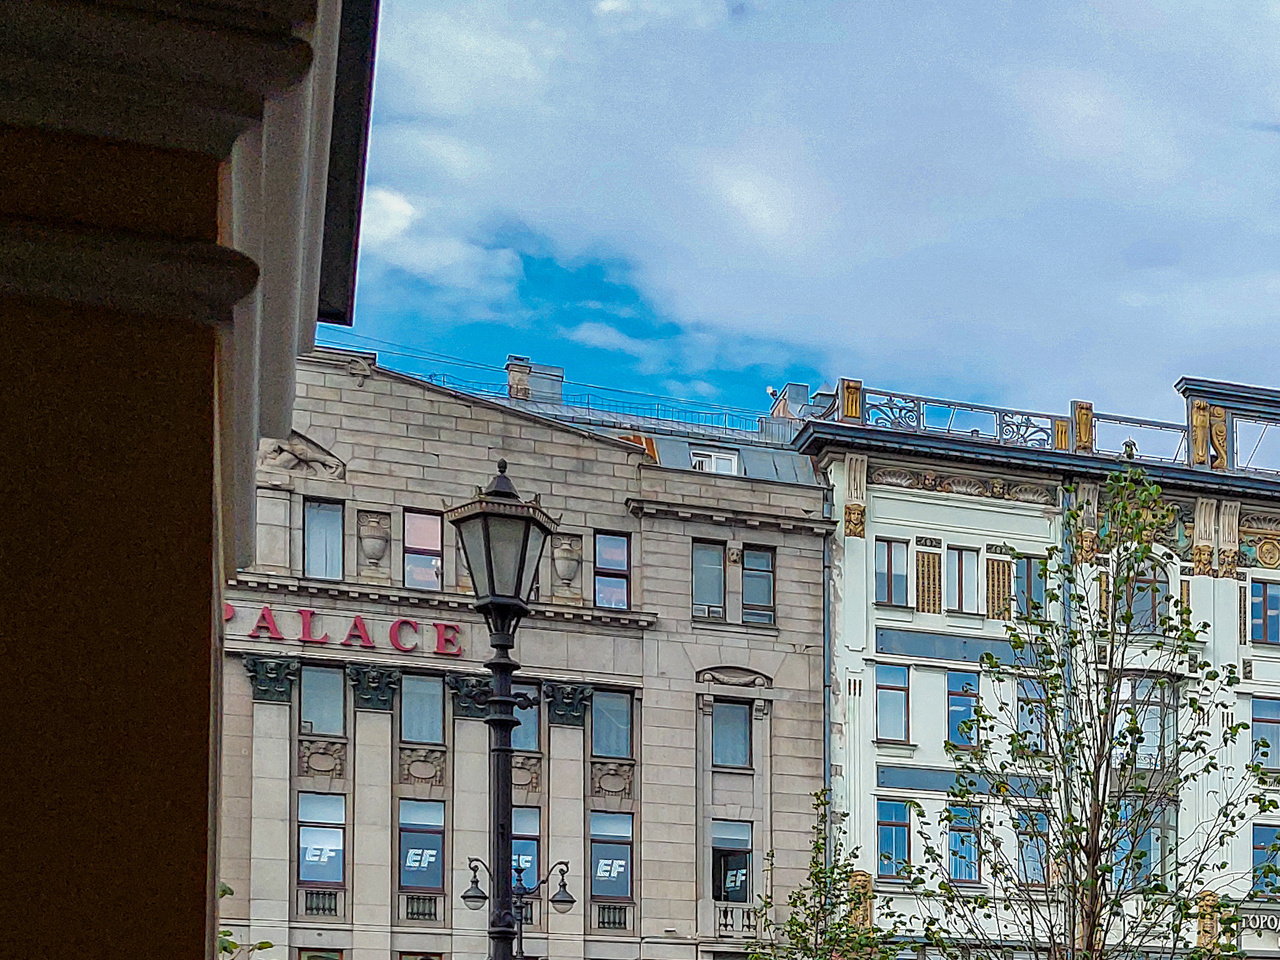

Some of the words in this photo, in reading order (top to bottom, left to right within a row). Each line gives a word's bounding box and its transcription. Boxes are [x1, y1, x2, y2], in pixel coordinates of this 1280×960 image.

[305, 846, 336, 862] EF
[405, 848, 437, 867] EF
[596, 859, 626, 877] EF
[726, 868, 747, 889] EF
